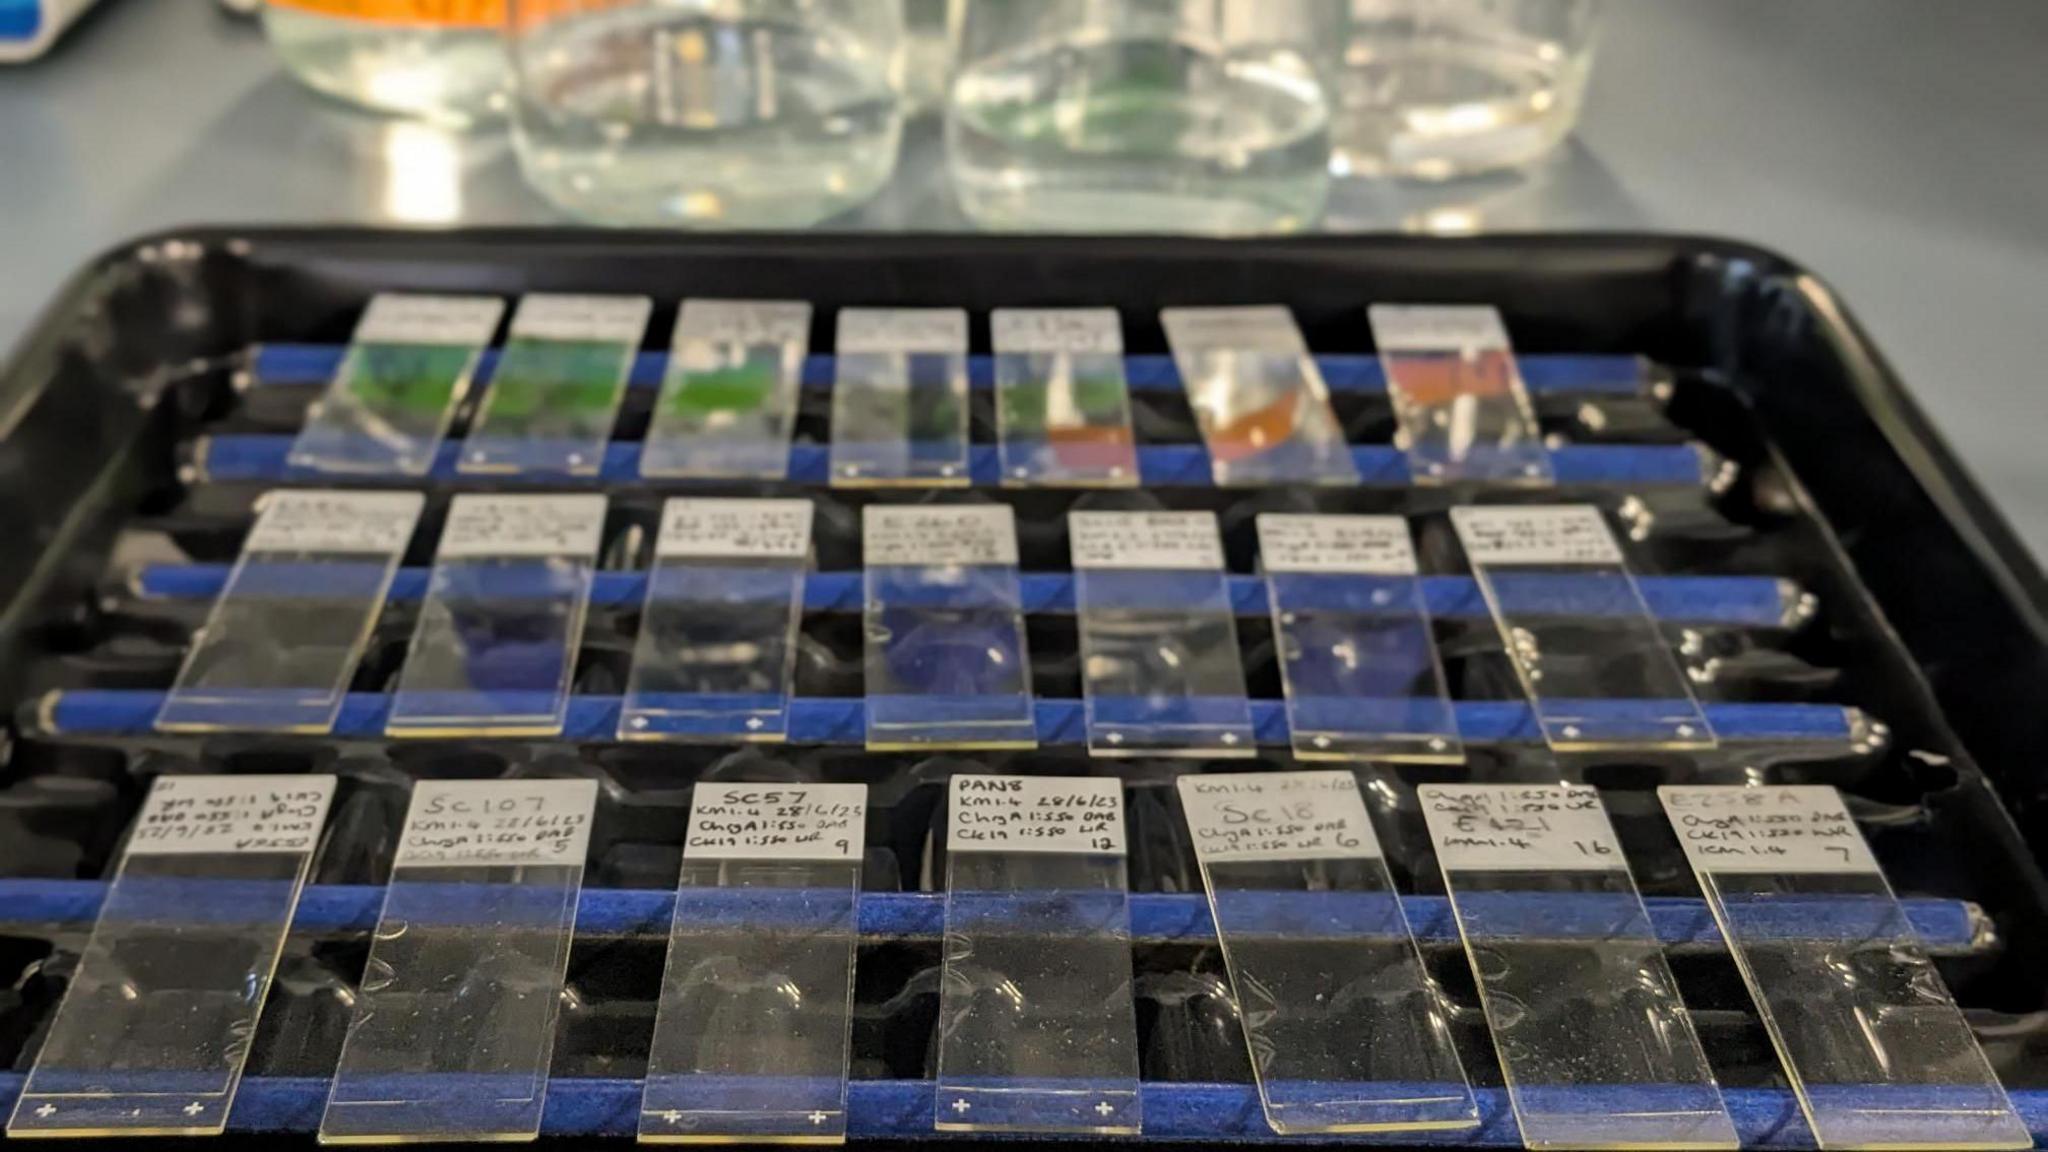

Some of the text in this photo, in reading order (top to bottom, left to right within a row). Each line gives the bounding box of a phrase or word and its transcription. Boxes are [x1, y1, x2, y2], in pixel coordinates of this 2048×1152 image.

[959, 779, 1023, 792] PAN8
[723, 791, 807, 804] SC57
[1037, 794, 1117, 808] 28/6/23
[1029, 811, 1075, 822] 1:550
[1019, 826, 1067, 837] 1:550
[835, 839, 849, 855] 9
[1091, 837, 1116, 850] 12
[1336, 833, 1359, 848] 6
[1823, 846, 1850, 862] 7
